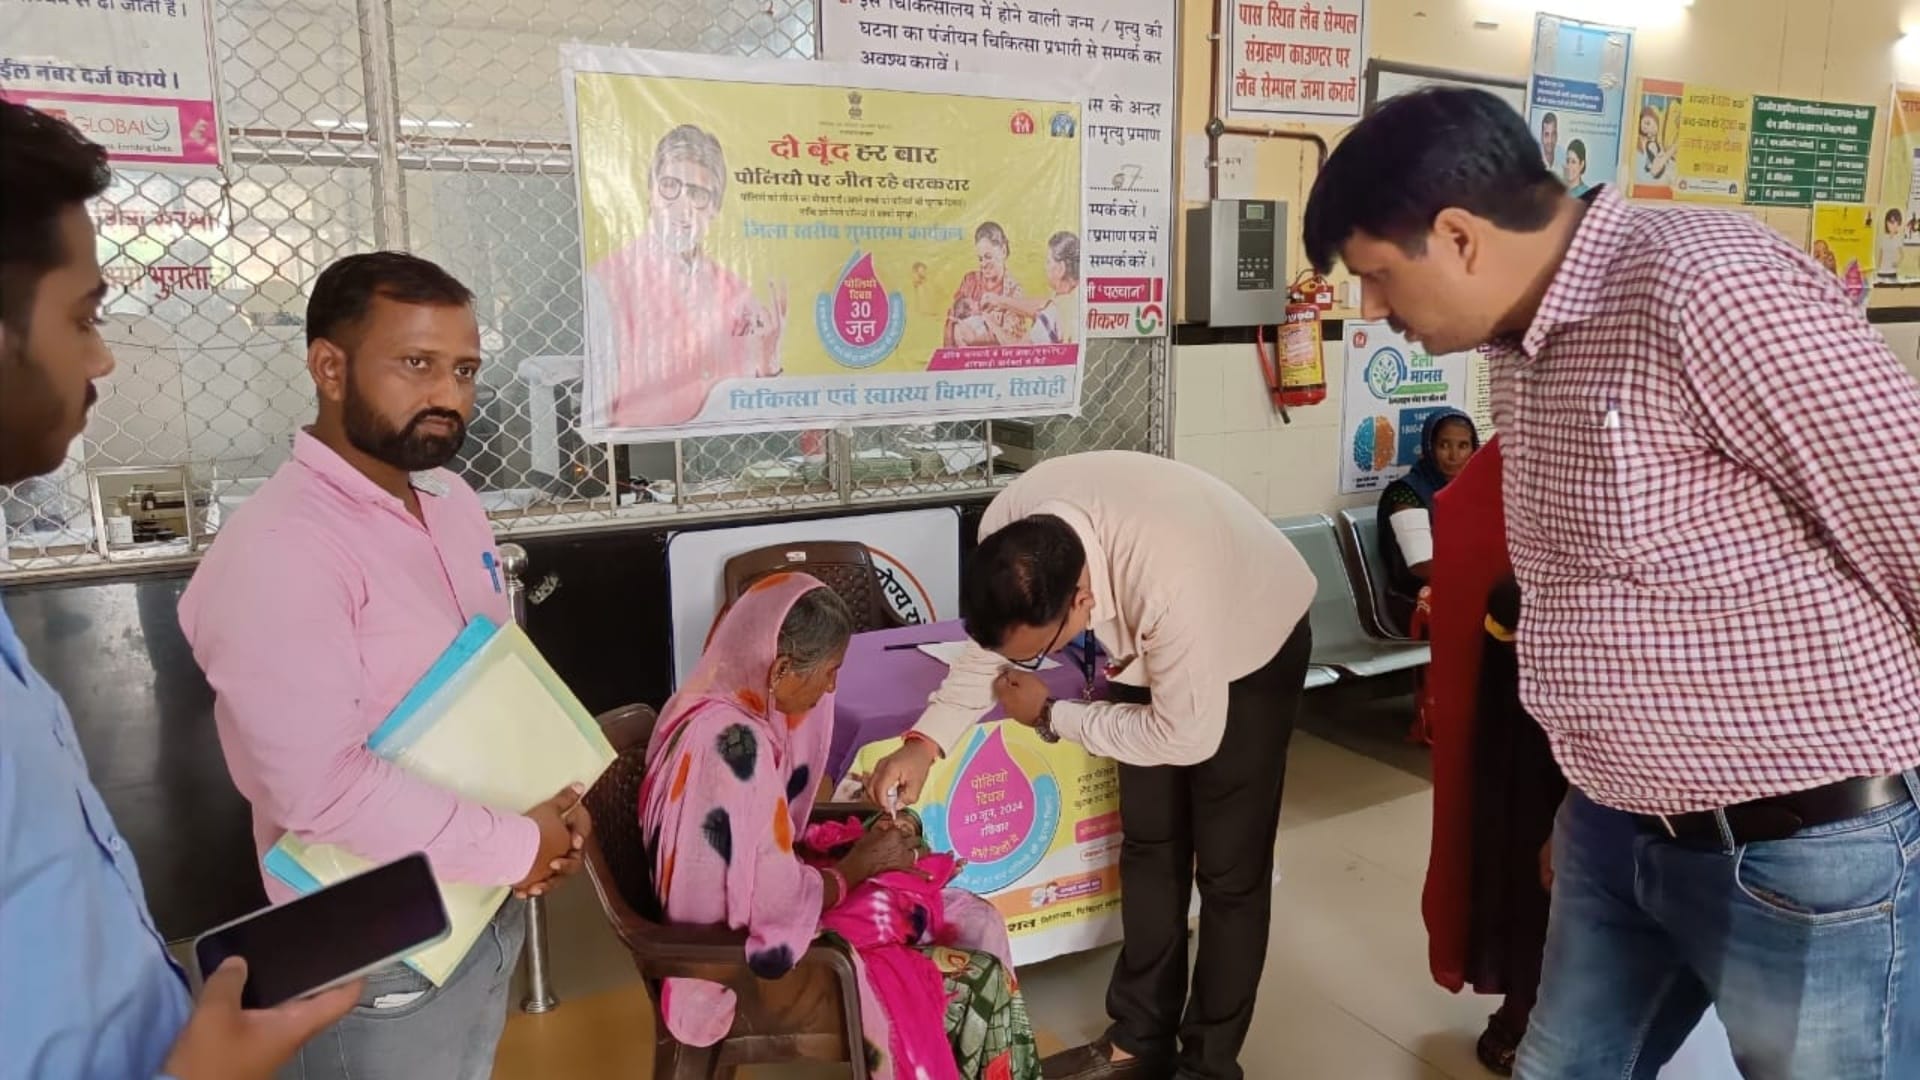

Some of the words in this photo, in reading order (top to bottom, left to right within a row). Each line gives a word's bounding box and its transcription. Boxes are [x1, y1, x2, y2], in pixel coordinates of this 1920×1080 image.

[998, 2, 1022, 24] होने
[1028, 3, 1060, 27] वाली
[1067, 14, 1094, 32] जन्म
[1115, 19, 1141, 42] मृत्यु
[1145, 18, 1163, 38] की
[1239, 4, 1263, 26] पास
[1267, 1, 1297, 29] स्थित
[1299, 3, 1320, 30] लैब
[1324, 5, 1358, 34] सेम्पल
[859, 20, 898, 41] घटना
[903, 24, 923, 42] का
[929, 23, 978, 48] पंजीयन
[983, 27, 1039, 53] चिकित्सा
[1045, 33, 1081, 58] प्रभारी
[1085, 38, 1097, 60] से
[1101, 41, 1140, 62] सम्पर्क
[1143, 48, 1163, 65] कर
[1245, 34, 1286, 63] संग्रहण
[1288, 44, 1333, 67] काउण्टर
[1336, 47, 1351, 68] पर
[860, 50, 907, 69] अवश्य
[909, 50, 950, 72] करावें
[0, 58, 30, 81] ईल
[35, 61, 76, 83] नंबर
[80, 65, 113, 85] दर्ज
[117, 68, 167, 89] कराये
[1236, 67, 1258, 97] लैब
[1261, 72, 1297, 100] सेम्पल
[1301, 79, 1325, 101] जमा
[1328, 76, 1357, 103] करावें
[1108, 94, 1124, 113] के
[1129, 101, 1161, 118] अन्दर
[72, 115, 147, 136] GLOBAL
[1100, 125, 1125, 146] मृत्यु
[1127, 127, 1161, 142] प्रमाण
[769, 134, 800, 159] दो
[855, 143, 888, 163] हर
[892, 144, 941, 165] बार
[734, 167, 803, 189] पोलियो
[808, 174, 831, 187] पर
[835, 171, 873, 190] जीत
[876, 173, 899, 189] रहे
[902, 178, 970, 193] बरकरार
[1088, 198, 1117, 217] म्पर्क
[1118, 198, 1138, 217] करें
[743, 218, 788, 239] जिला
[794, 219, 840, 239] स्तरीय
[1093, 230, 1127, 243] प्रमाण
[1129, 230, 1146, 243] पत्र
[1147, 225, 1159, 243] में
[1089, 249, 1127, 268] सम्पर्क
[1128, 249, 1148, 268] करें
[845, 277, 877, 290] पोलियो
[849, 289, 873, 301] दिवस
[850, 302, 872, 318] 30
[1087, 308, 1130, 330] ीकरण
[844, 318, 876, 345] जून
[1410, 369, 1443, 383] मानस
[729, 387, 820, 412] चिकित्सा
[827, 383, 857, 407] एवं
[863, 384, 928, 406] स्वास्थ्य
[935, 379, 1001, 402] विभाग,
[1010, 376, 1067, 399] सिरोही
[971, 768, 1009, 791] पोलियो
[976, 789, 1006, 806] दिवस
[963, 813, 977, 825] 30
[1000, 801, 1025, 816] 2024
[981, 821, 1009, 838] रविवार
